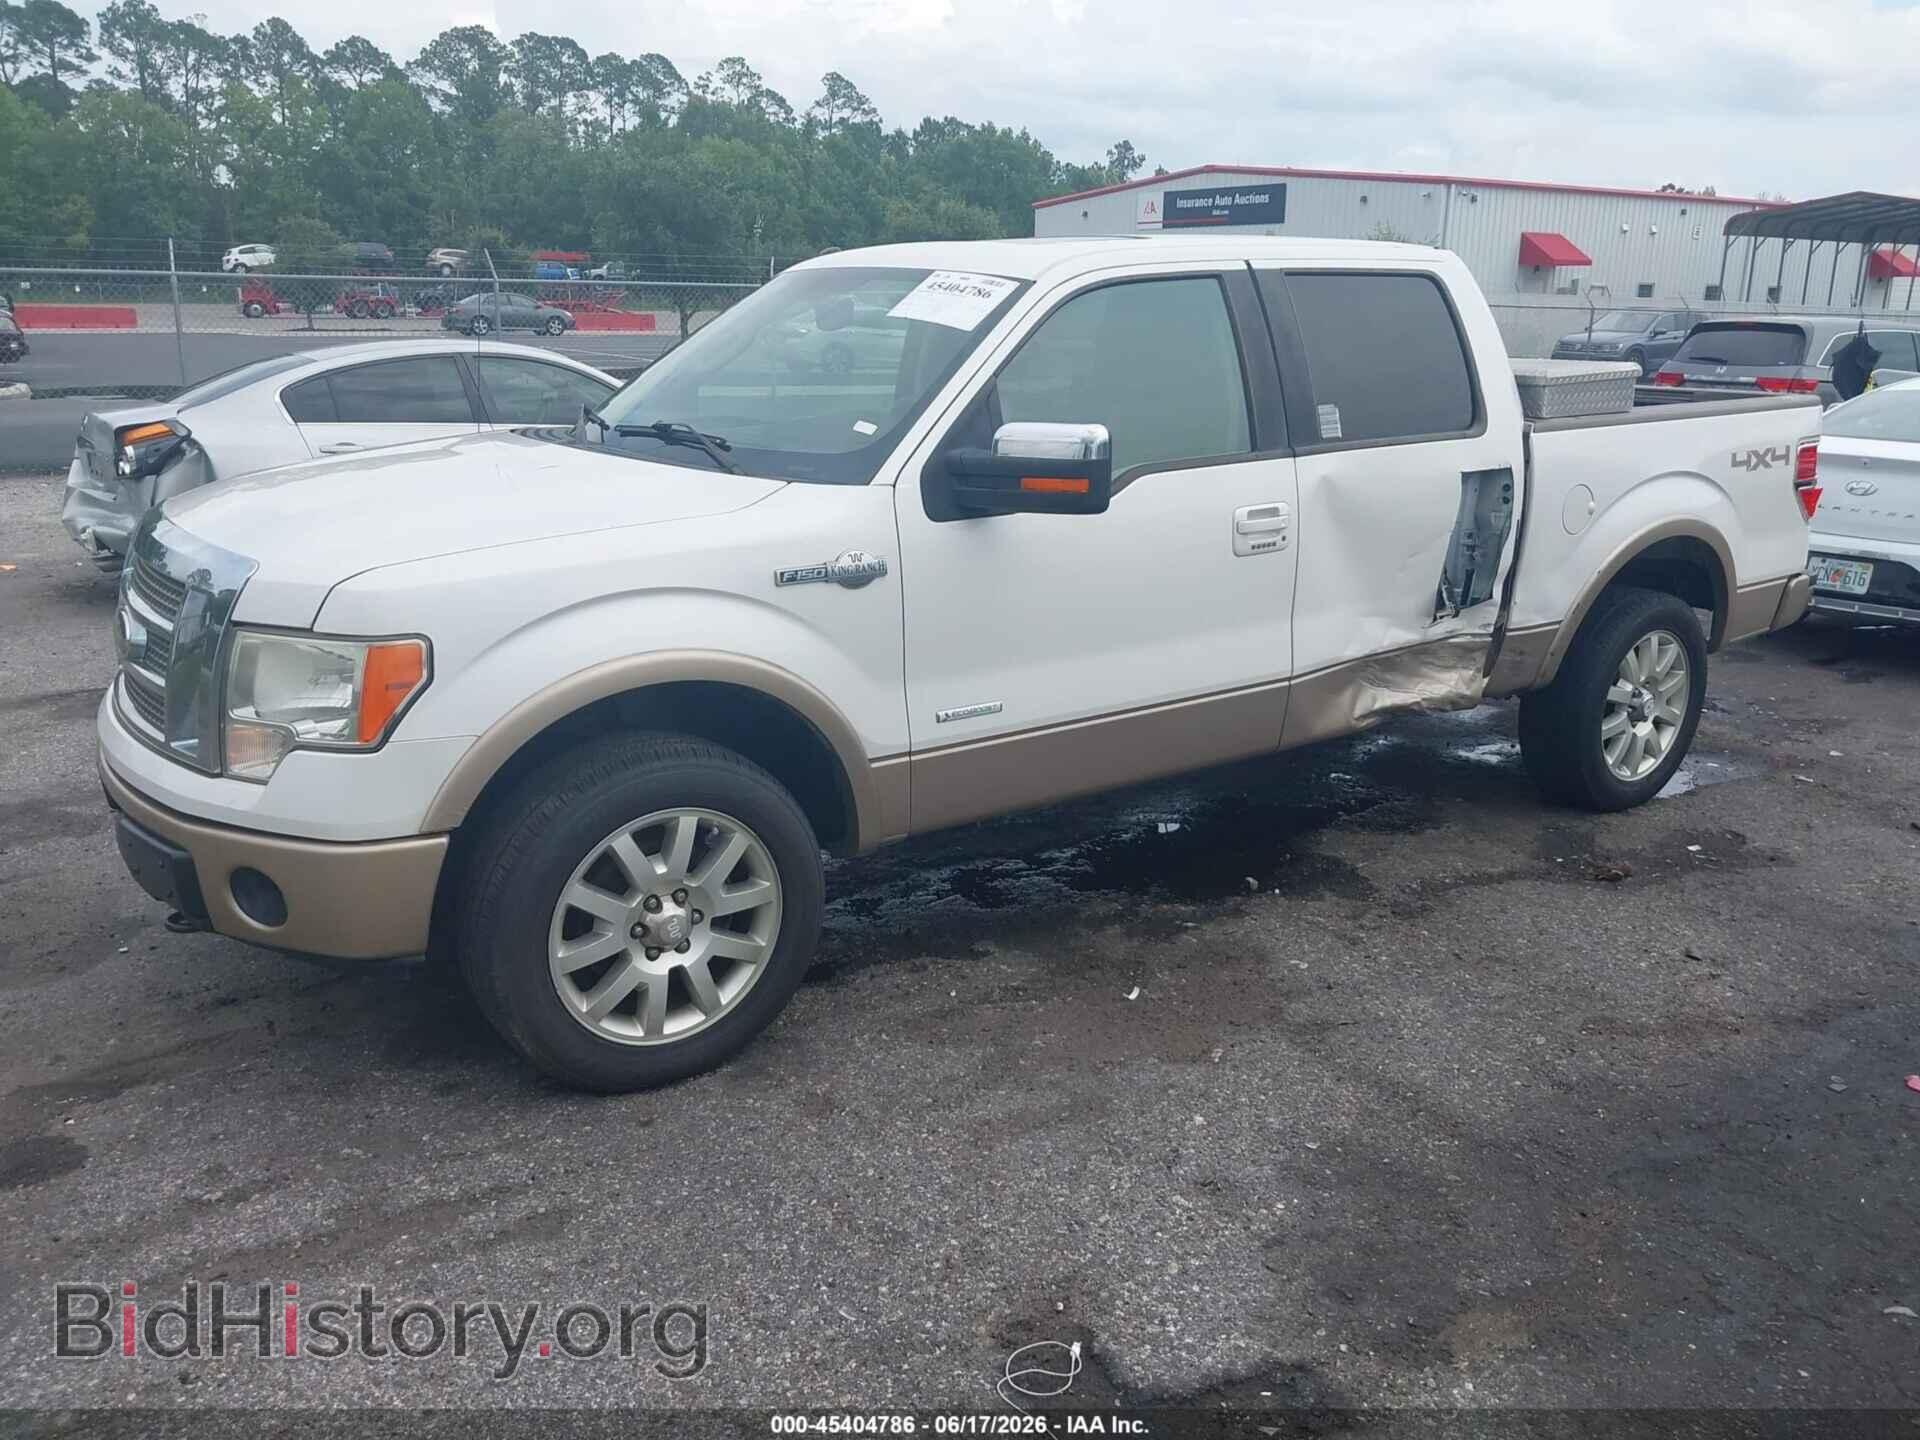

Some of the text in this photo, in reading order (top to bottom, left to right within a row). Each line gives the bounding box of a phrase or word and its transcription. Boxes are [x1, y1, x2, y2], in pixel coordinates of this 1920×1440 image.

[1176, 192, 1270, 209] Insurance Auto Auctions
